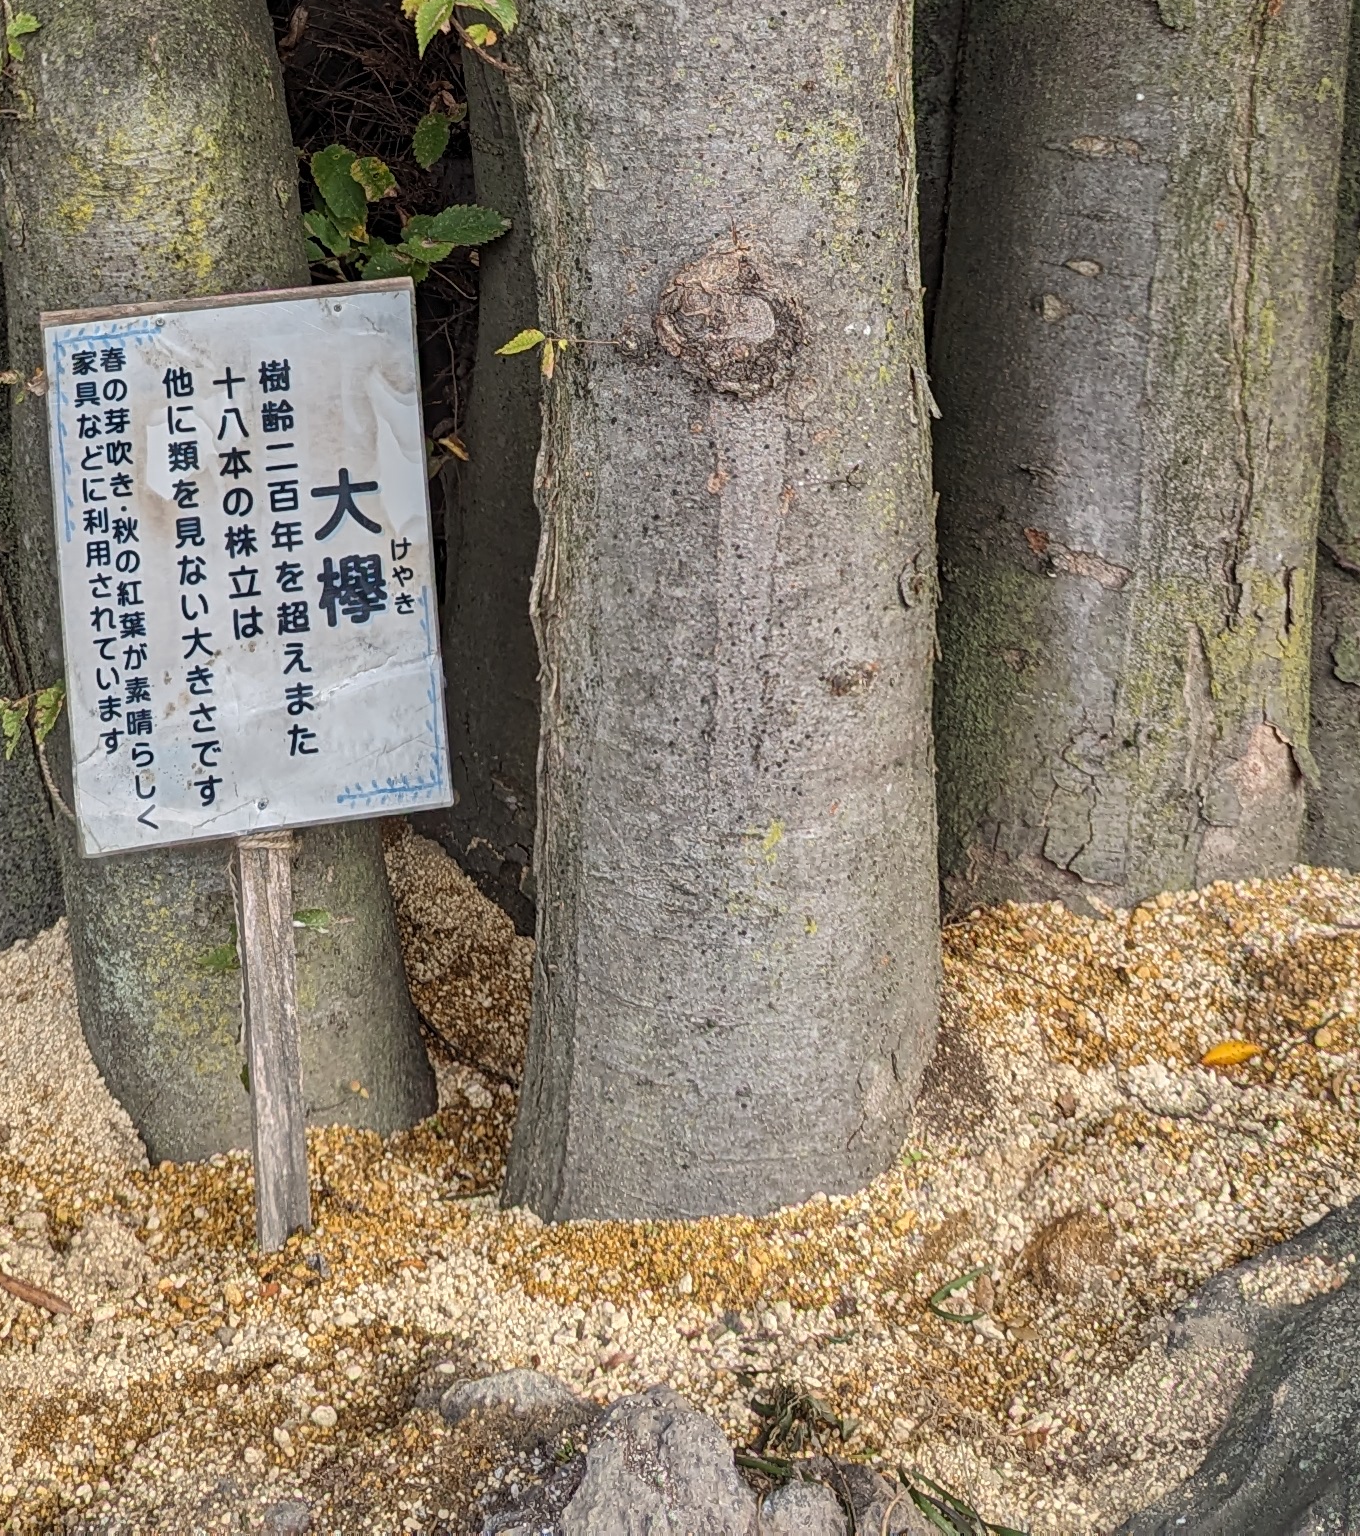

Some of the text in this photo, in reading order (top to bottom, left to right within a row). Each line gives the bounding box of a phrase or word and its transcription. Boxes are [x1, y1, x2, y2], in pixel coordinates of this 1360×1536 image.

[71, 349, 124, 755] 家具などに利用されています
[100, 346, 159, 830] 春の芽吹き・秋の紅葉が素晴らしく
[162, 366, 223, 807] 他に類を見ない大きさです
[212, 366, 263, 640] 十八本の株立は
[258, 358, 319, 756] 樹齢二百年を超えまた
[310, 467, 388, 627] 大欅
[391, 537, 415, 615] けやき
